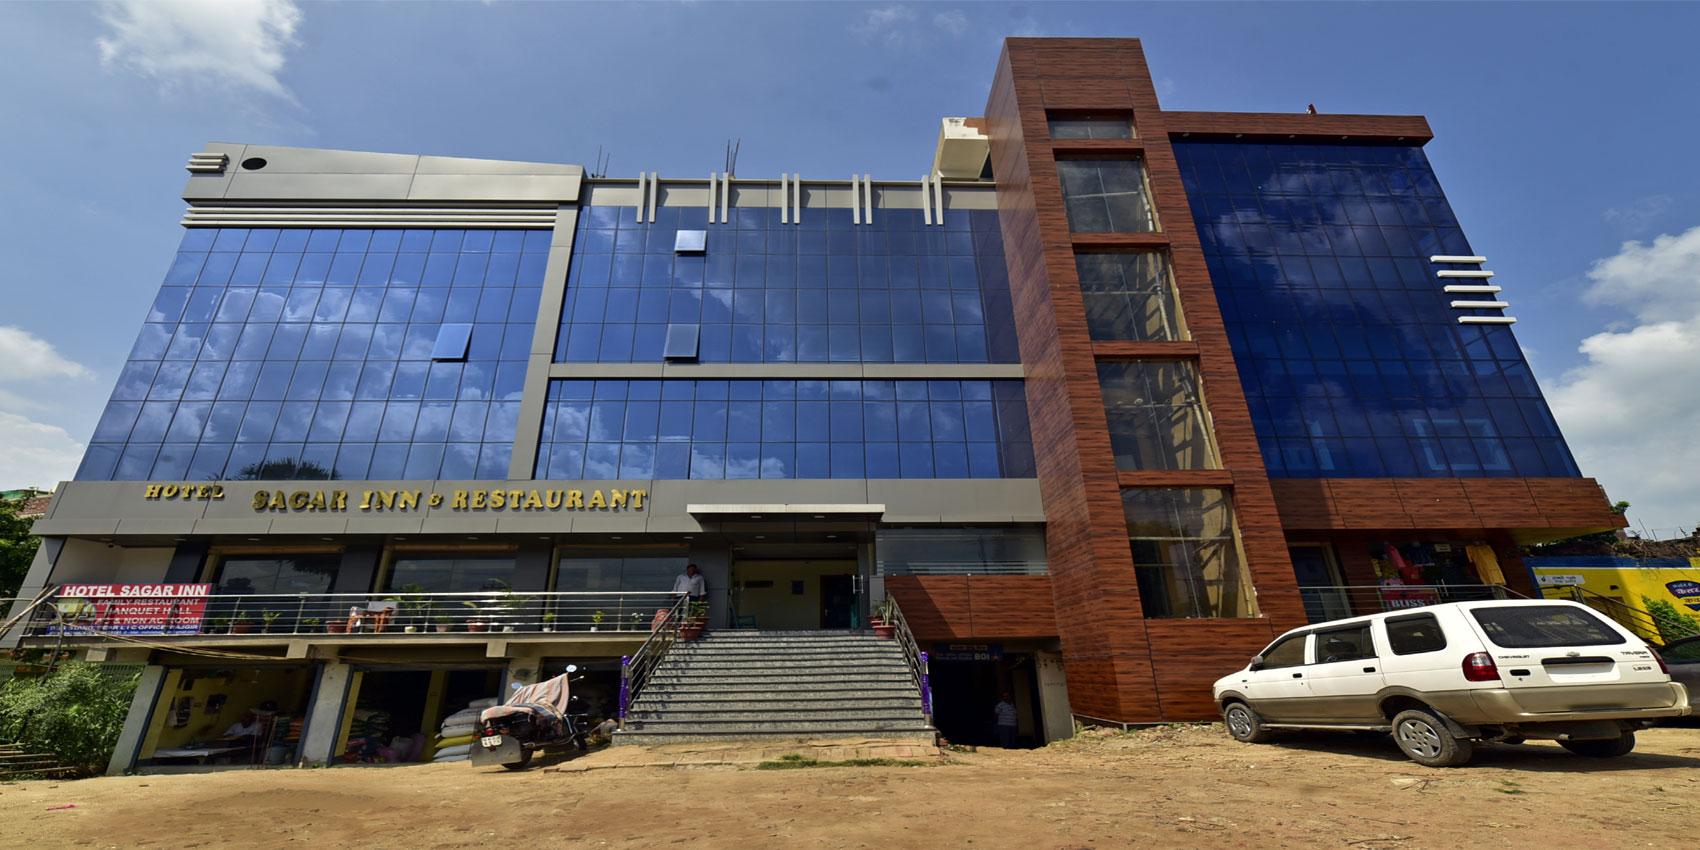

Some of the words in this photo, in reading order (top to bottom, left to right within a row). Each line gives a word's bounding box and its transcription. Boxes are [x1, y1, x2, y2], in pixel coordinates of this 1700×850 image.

[144, 484, 225, 498] HOTEL
[252, 489, 348, 510] SAGAR
[359, 489, 422, 510] INN
[428, 493, 443, 507] &
[452, 488, 648, 510] RESTAURANT
[64, 585, 115, 597] HOTEL
[120, 585, 175, 597] SAGAR
[177, 585, 207, 597] INN
[1391, 599, 1425, 607] BLISS
[104, 606, 160, 614] ANQUET
